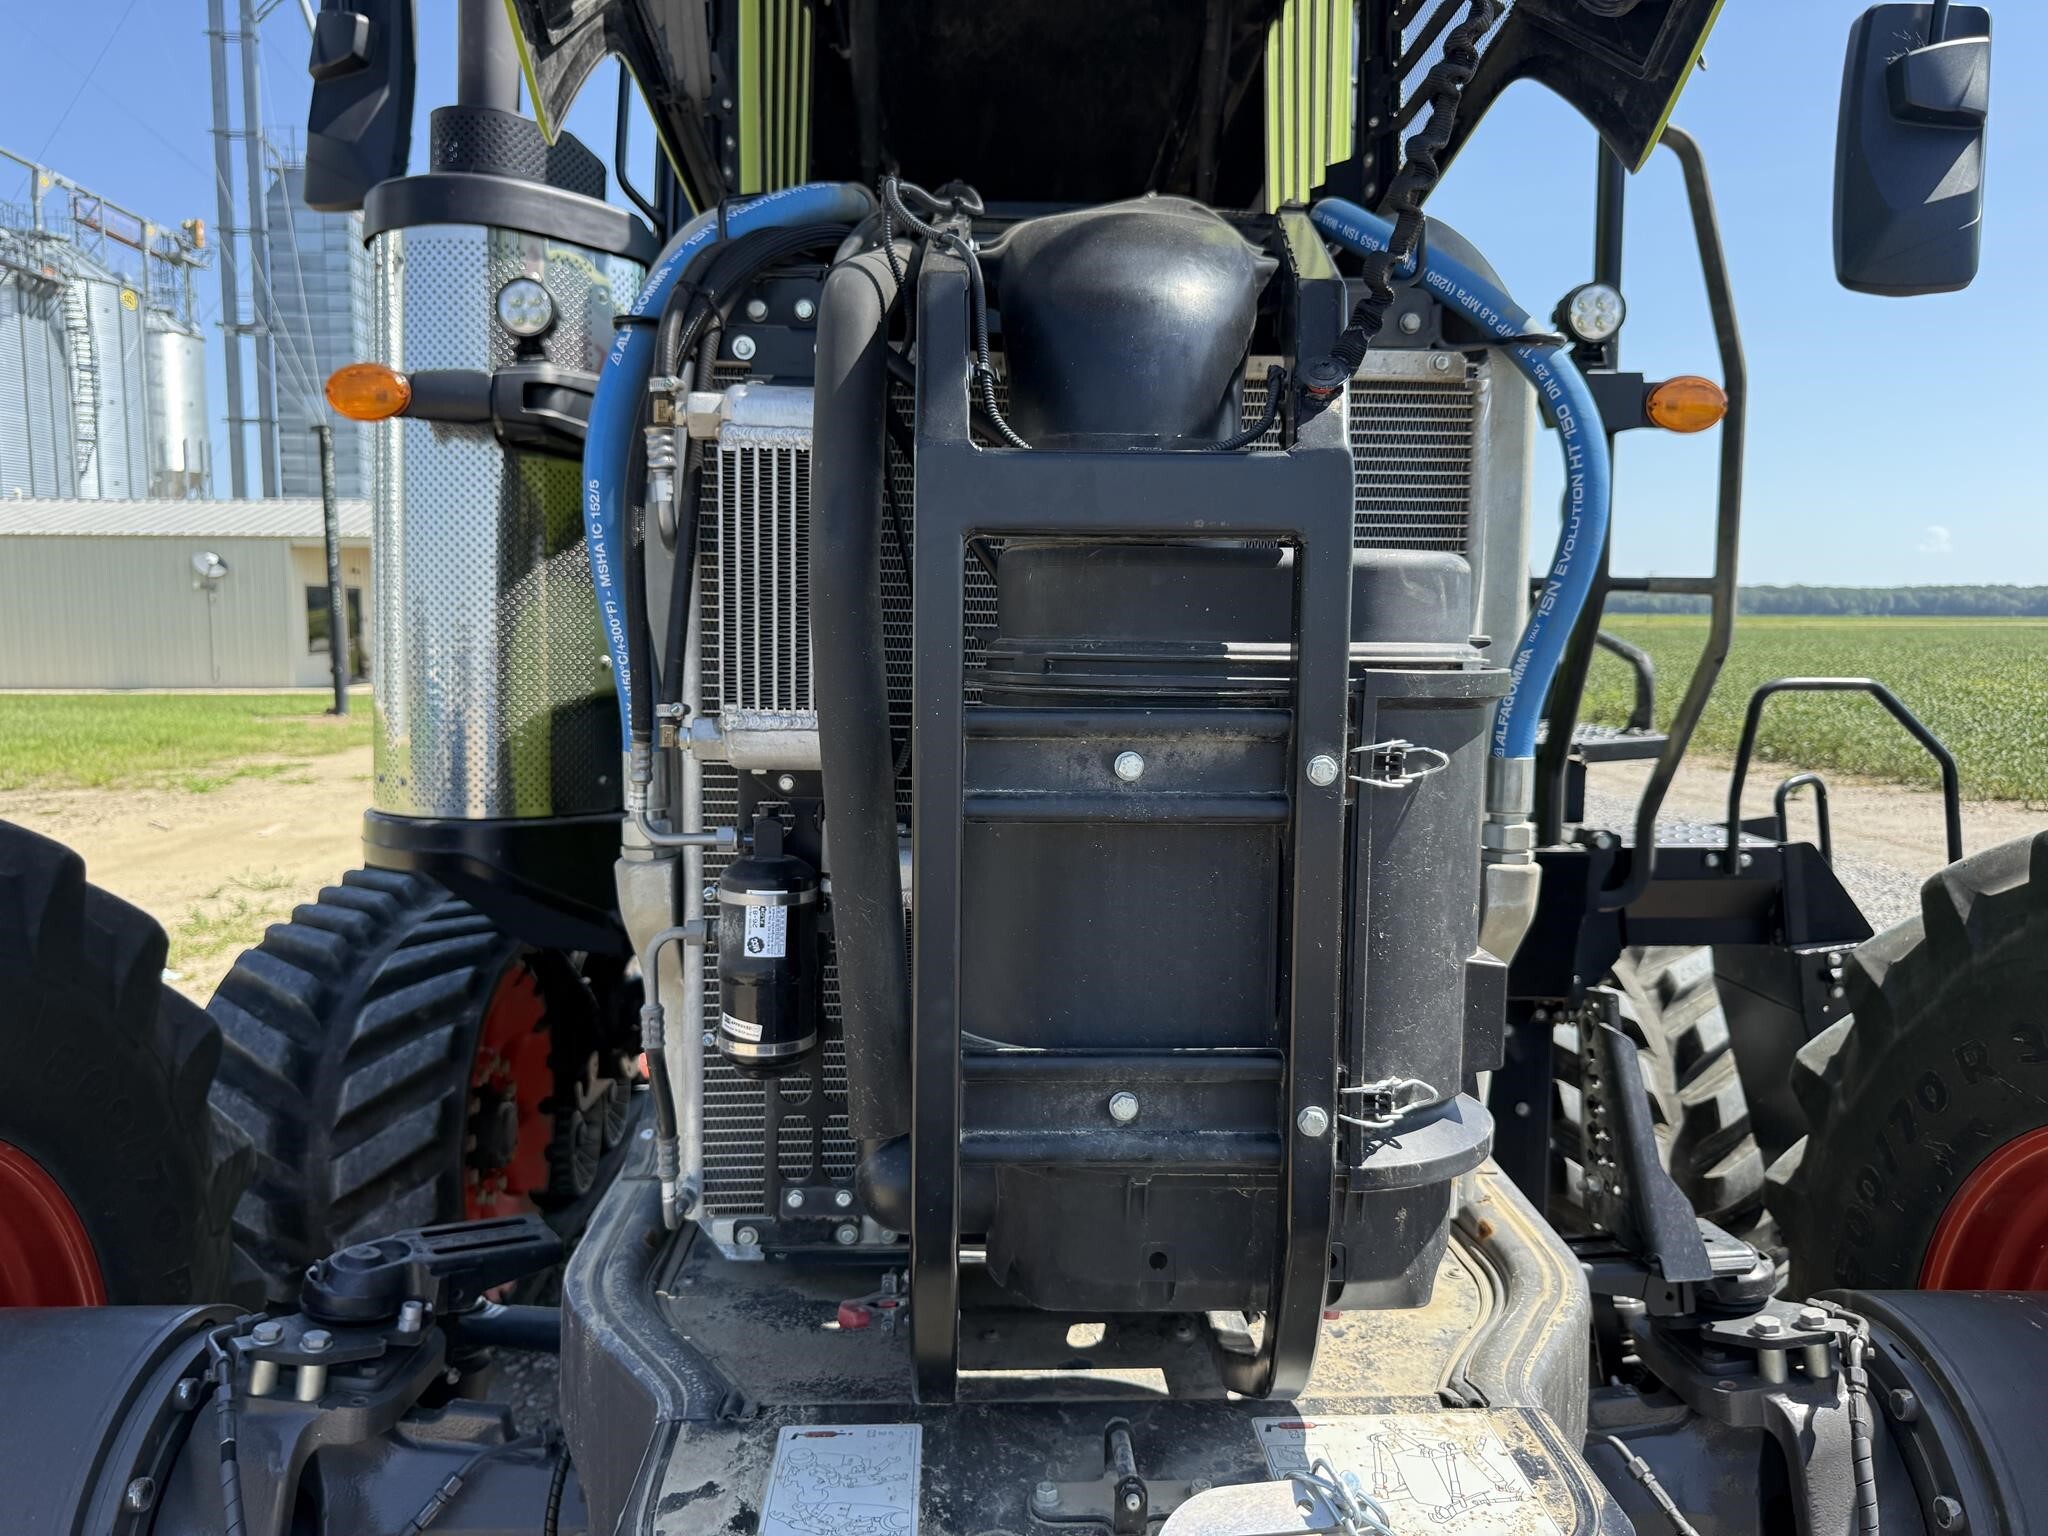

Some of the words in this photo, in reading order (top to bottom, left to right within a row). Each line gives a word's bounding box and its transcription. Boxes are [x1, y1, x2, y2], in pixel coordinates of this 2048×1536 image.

[1359, 234, 1381, 251] 853
[617, 266, 672, 354] ALFGOMMA
[685, 223, 719, 248] 1SN
[726, 191, 791, 221] VOLUTION
[1426, 270, 1458, 294] (1280
[1458, 288, 1483, 313] MPa
[1480, 305, 1498, 326] 8.8
[1496, 324, 1522, 341] WP
[1533, 364, 1547, 380] 25
[1544, 381, 1563, 401] DN
[1567, 444, 1585, 469] HT
[588, 479, 602, 517] 152/5
[590, 522, 603, 539] IC
[1555, 476, 1585, 576] EVOLUTION
[594, 542, 612, 588] MSHA
[1537, 580, 1563, 618] 1SN
[1528, 624, 1541, 644] ITALY
